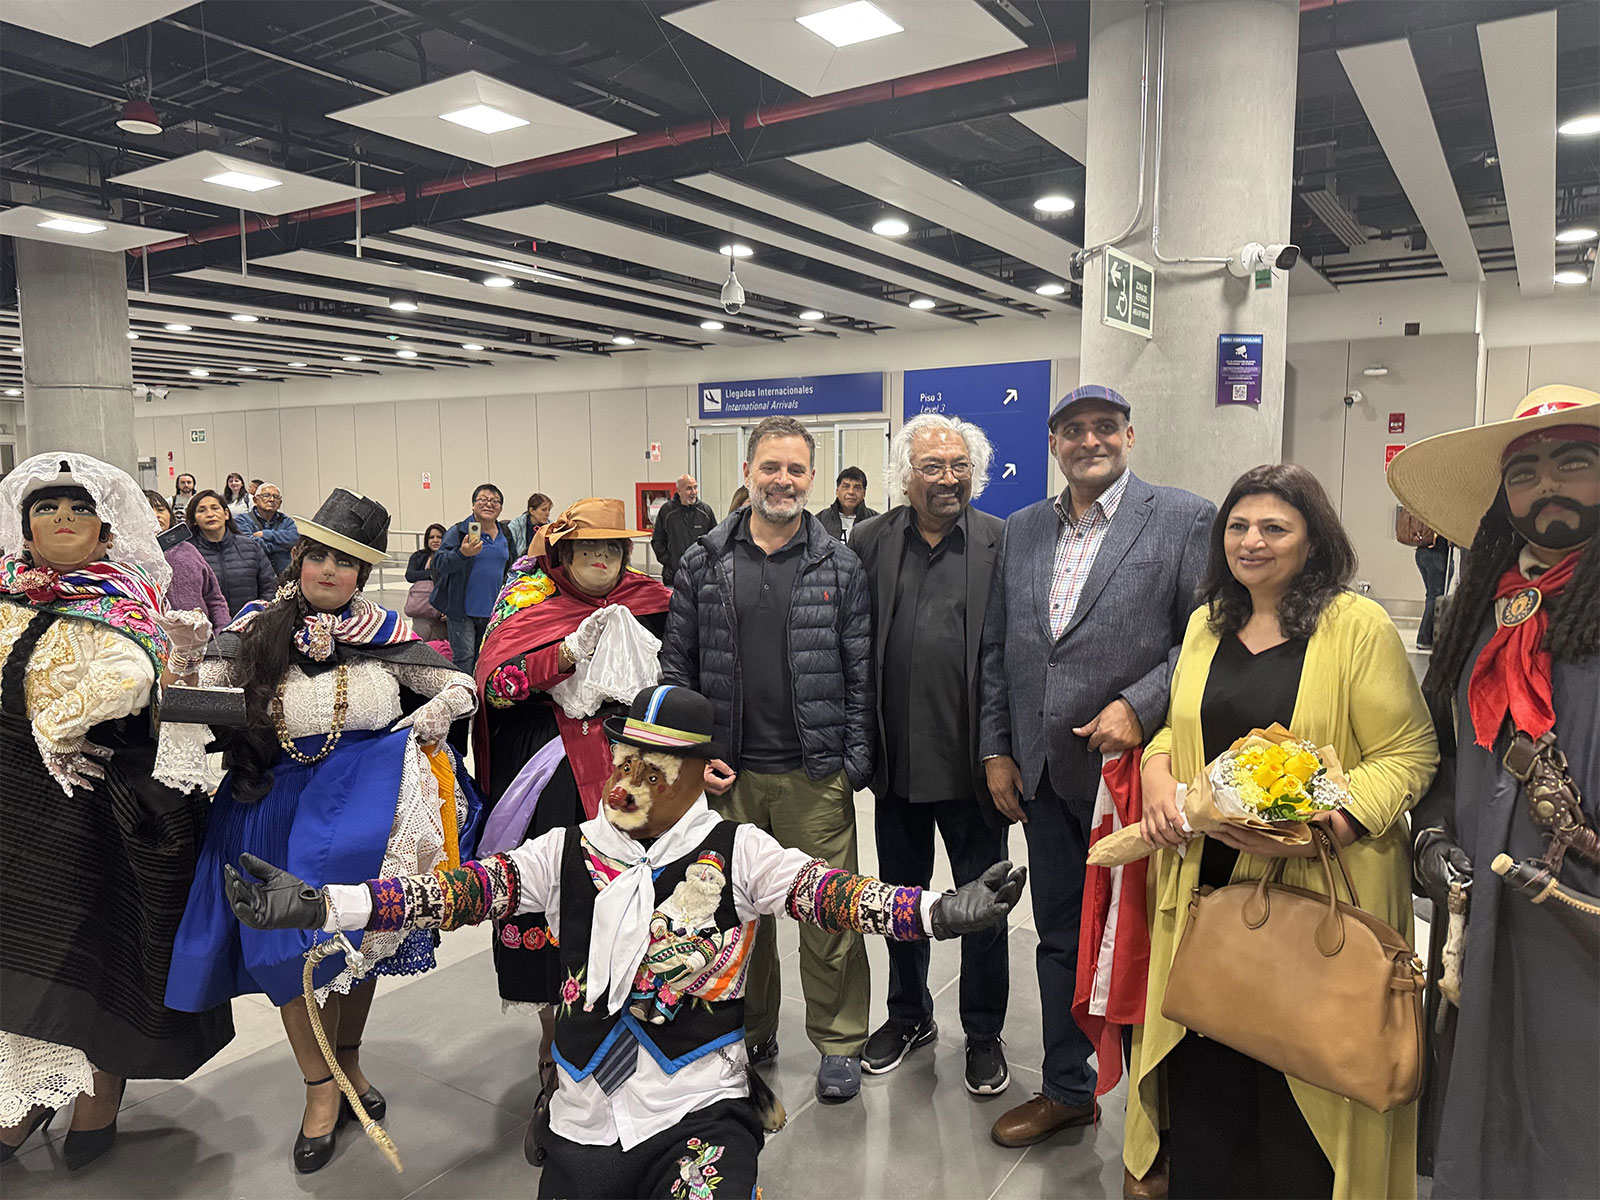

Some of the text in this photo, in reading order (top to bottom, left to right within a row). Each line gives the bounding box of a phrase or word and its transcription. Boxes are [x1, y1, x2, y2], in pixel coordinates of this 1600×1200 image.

[725, 385, 814, 400] Llegadas Internacionales
[920, 391, 942, 402] Piso 3
[725, 399, 799, 412] International Arrivals
